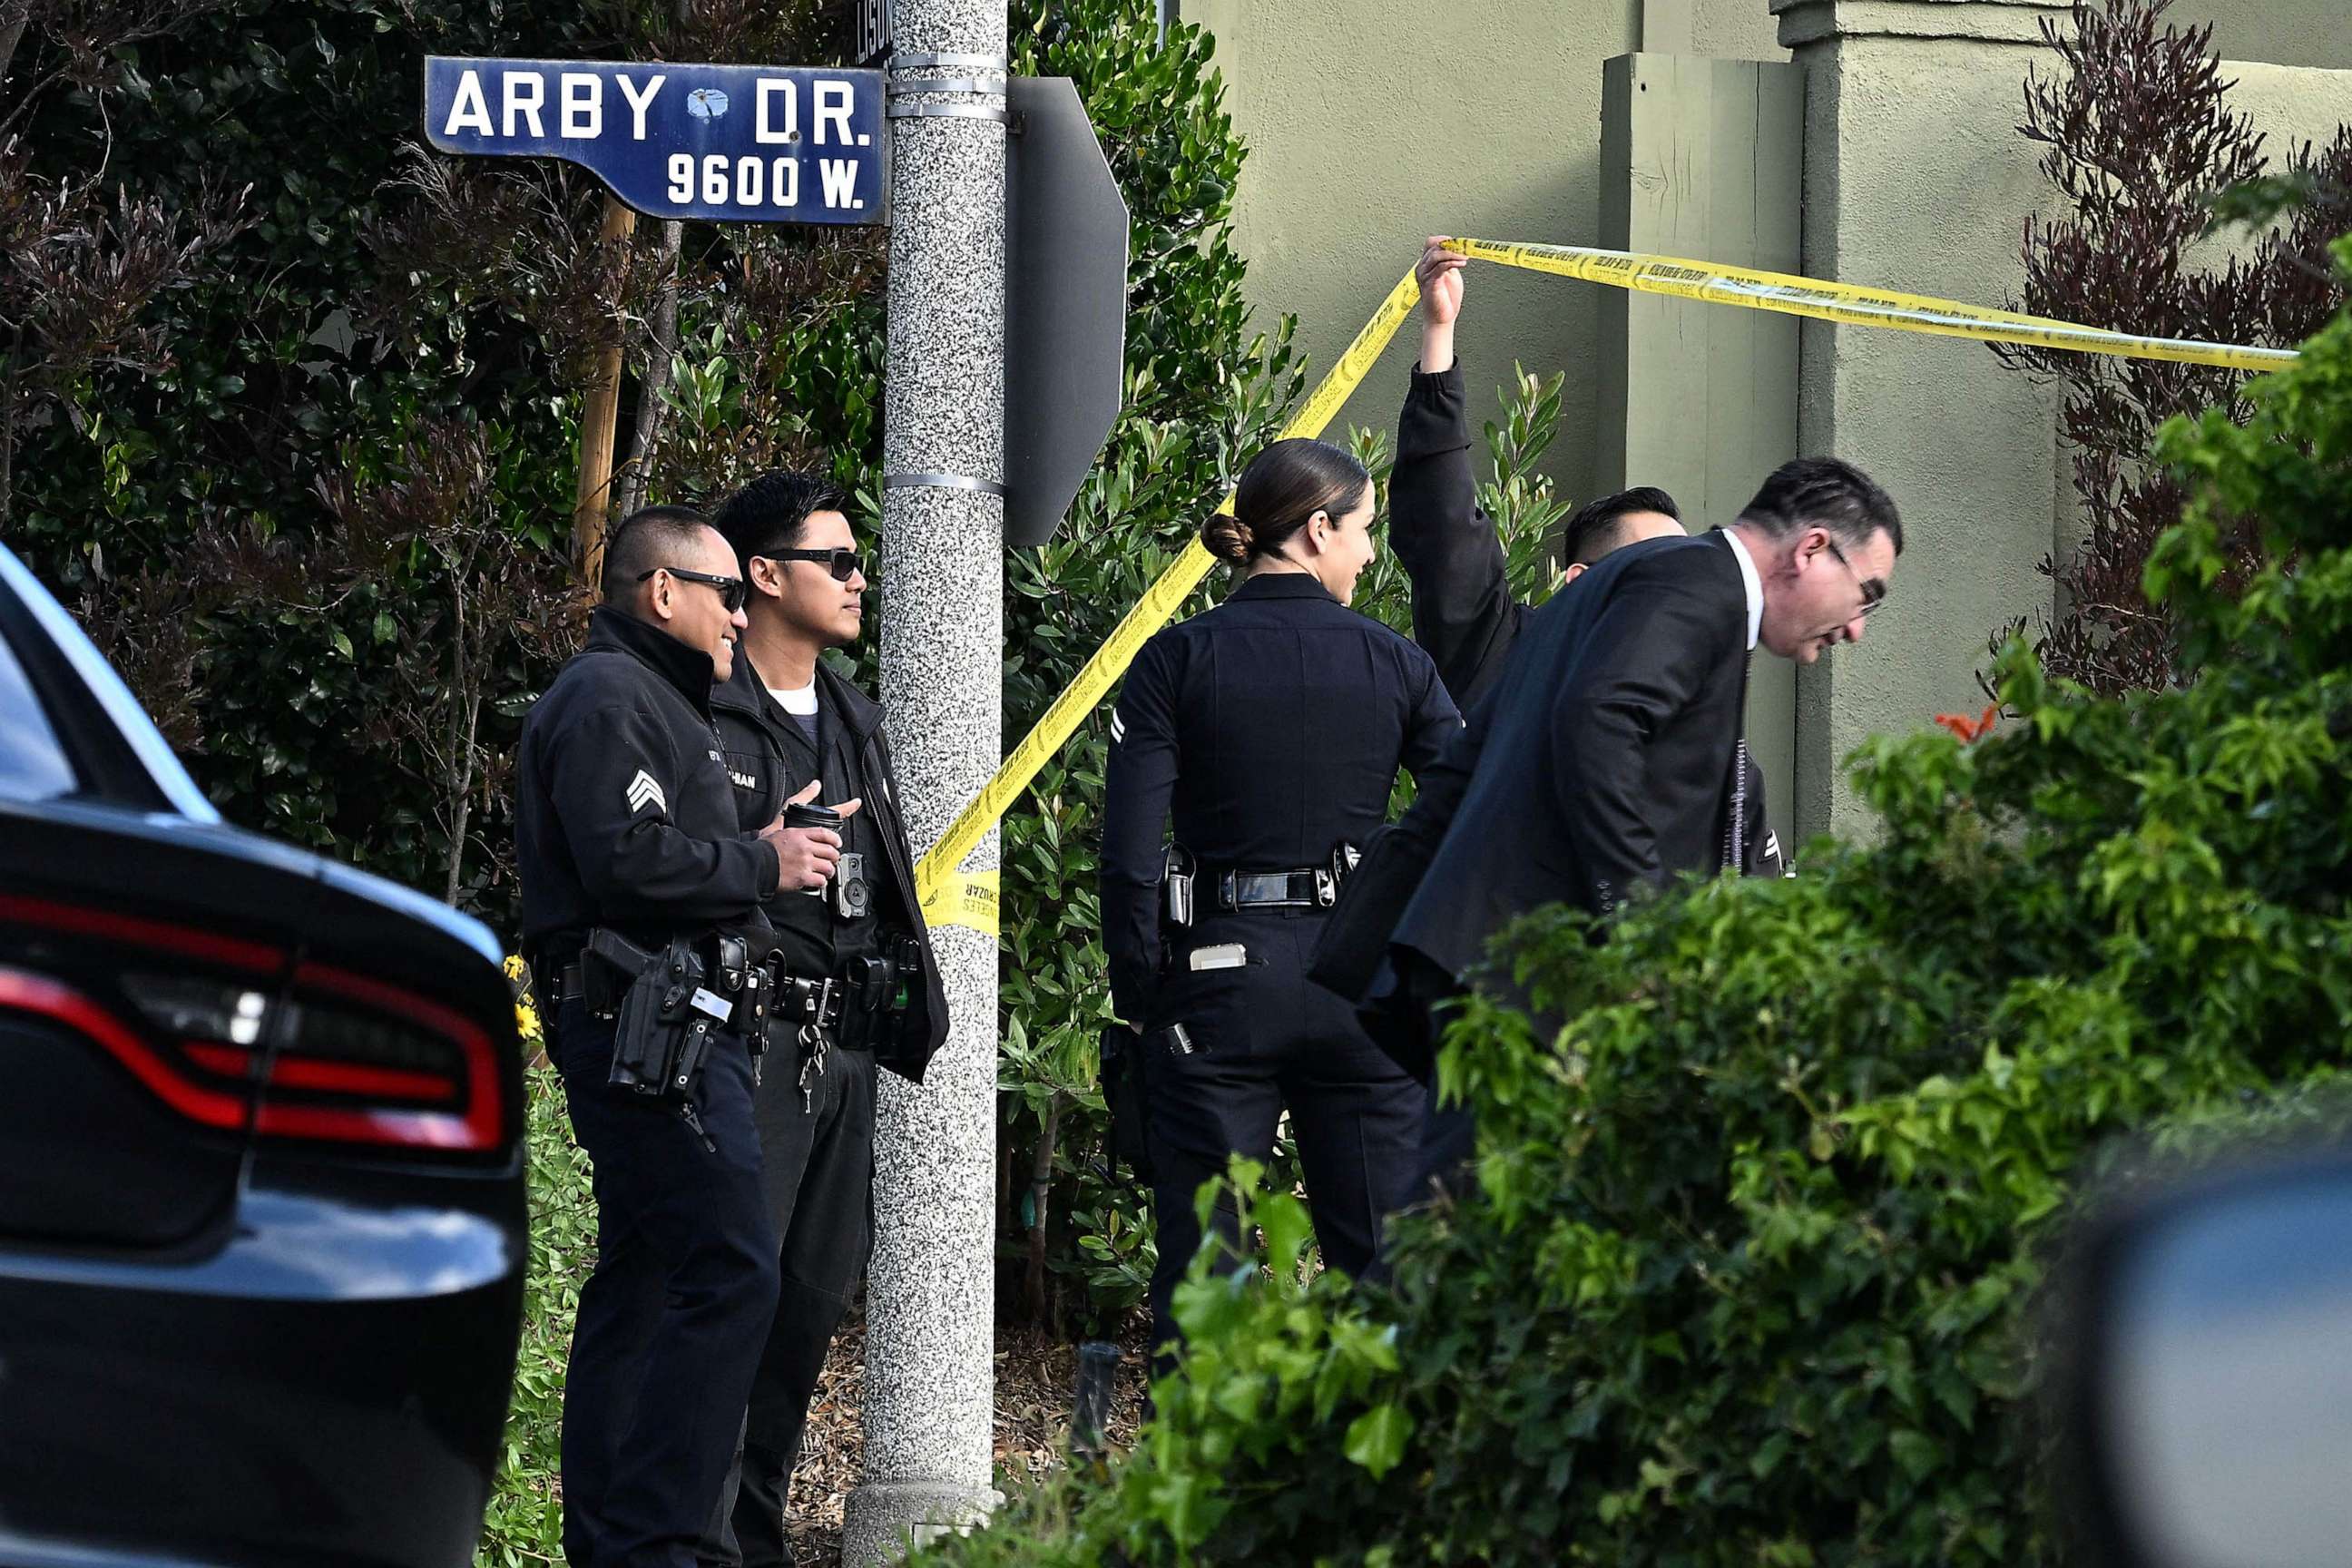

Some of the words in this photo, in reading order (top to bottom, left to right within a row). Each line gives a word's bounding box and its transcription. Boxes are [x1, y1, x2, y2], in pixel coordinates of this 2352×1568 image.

[445, 71, 665, 140] ARBY
[756, 78, 869, 145] DR.
[669, 154, 798, 206] 9600
[820, 159, 863, 208] W.
